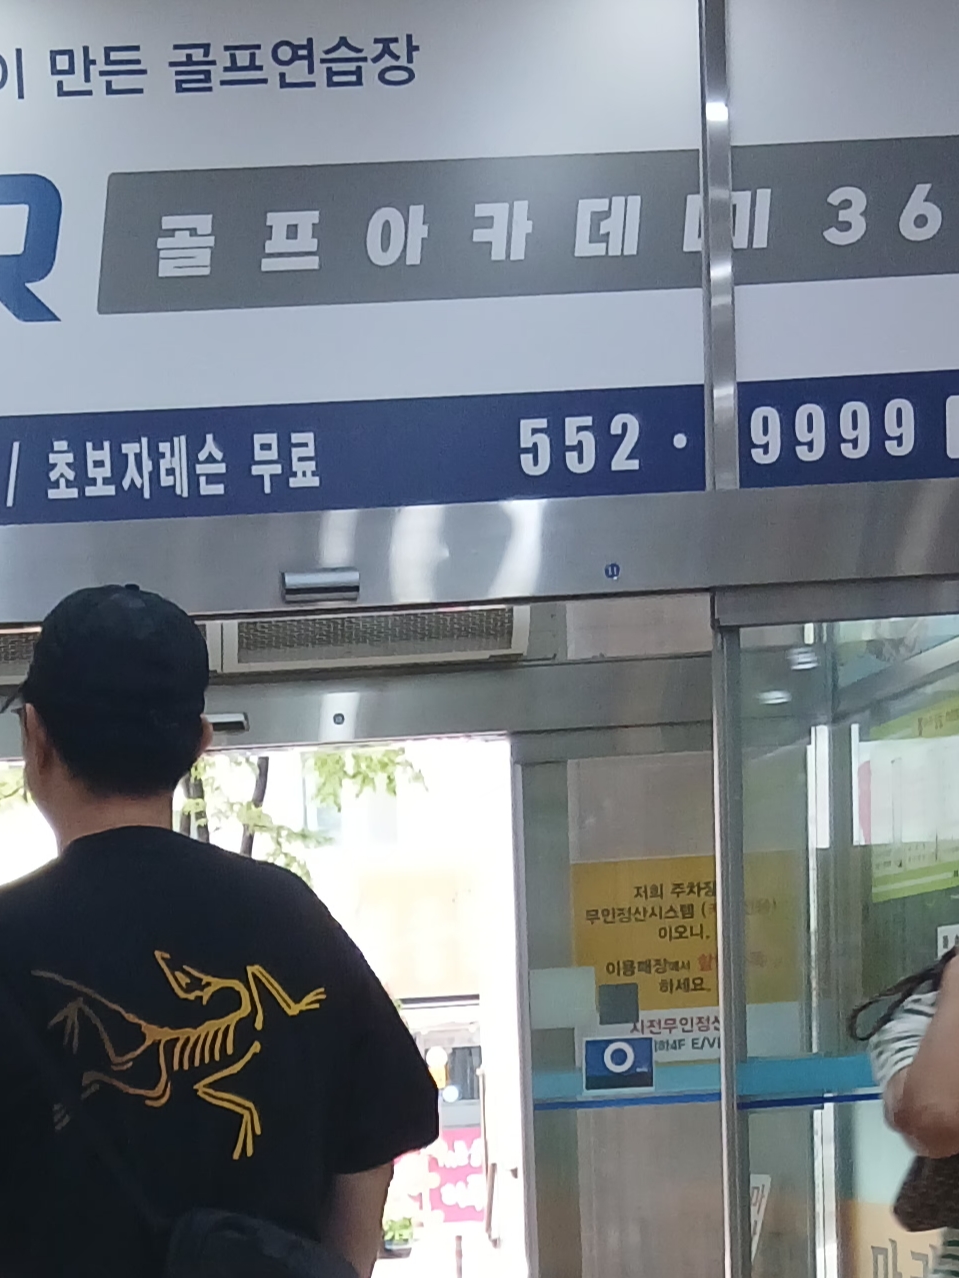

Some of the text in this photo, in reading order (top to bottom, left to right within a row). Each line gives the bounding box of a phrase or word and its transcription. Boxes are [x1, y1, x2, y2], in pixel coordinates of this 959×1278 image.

[49, 44, 147, 97] 만든
[168, 33, 420, 93] 골프연습장
[46, 432, 227, 500] 초보자레슨
[251, 431, 321, 494] 무료
[585, 902, 695, 925] 무인정산시스템
